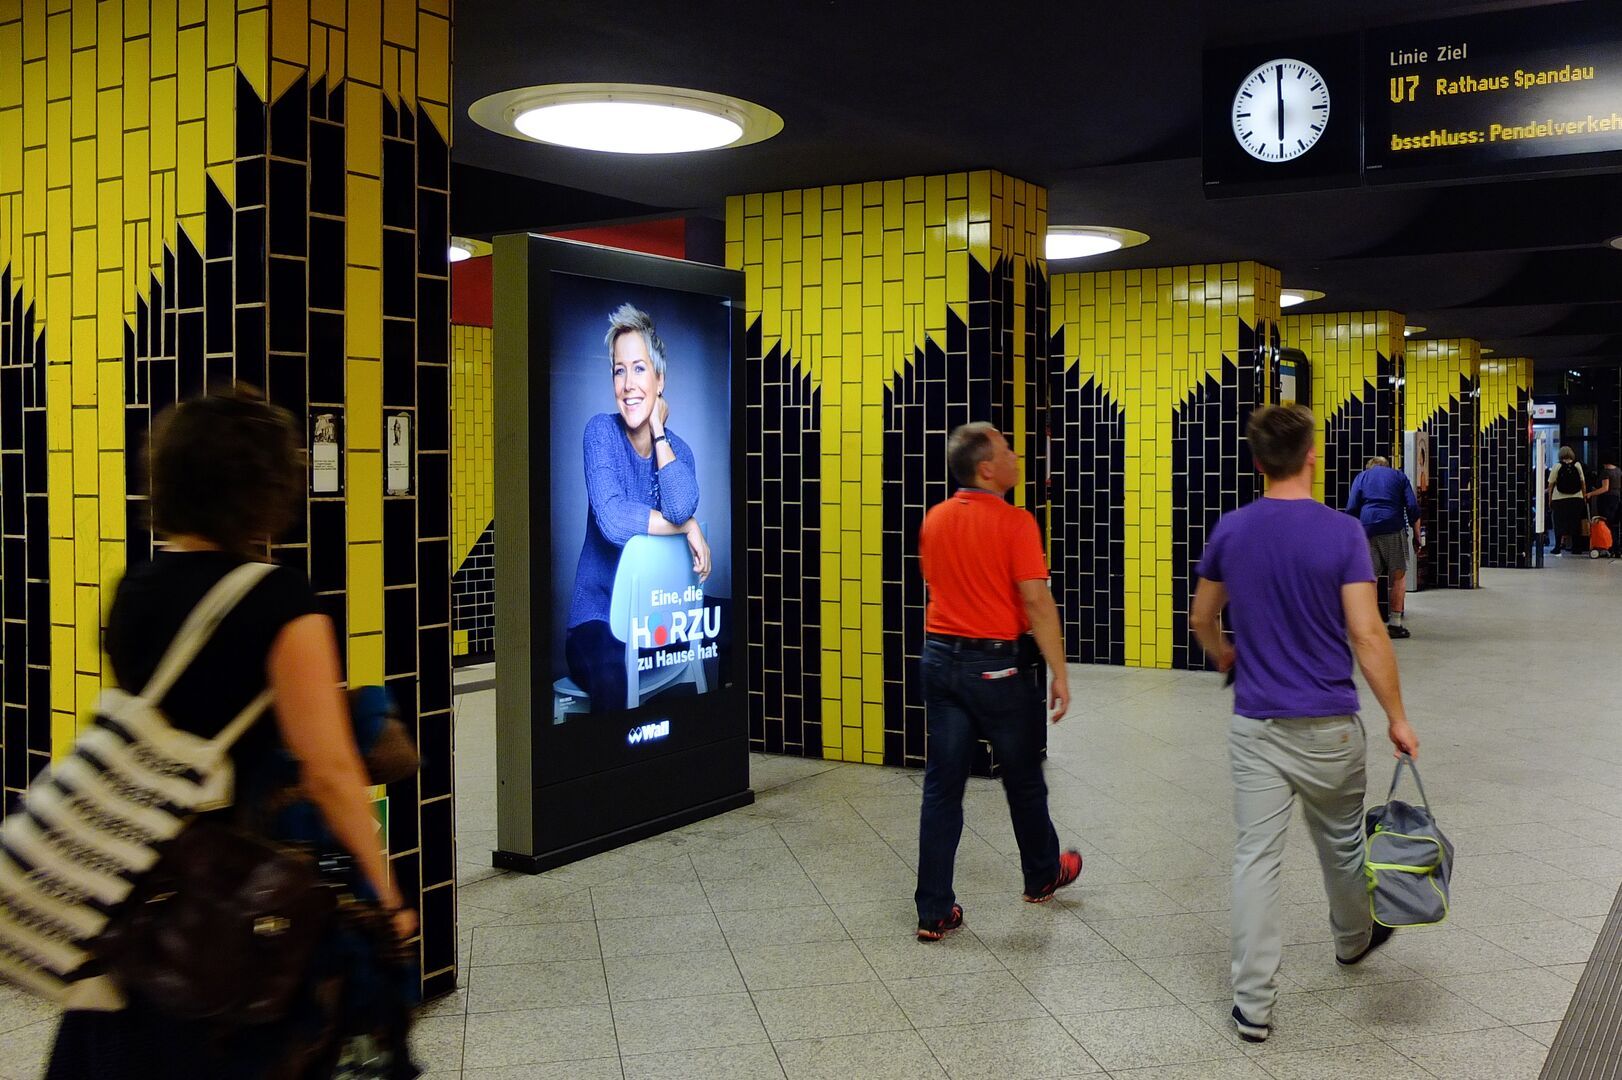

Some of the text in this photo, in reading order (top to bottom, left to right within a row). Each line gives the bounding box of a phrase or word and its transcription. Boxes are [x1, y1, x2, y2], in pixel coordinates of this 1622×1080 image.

[1390, 43, 1467, 66] Linie Ziel
[1390, 64, 1594, 103] U7 Rathaus Spandau
[1391, 129, 1485, 151] bsschluss:
[651, 585, 703, 607] Eine, die
[637, 642, 718, 671] zu Hause hat
[641, 720, 670, 741] Wall
